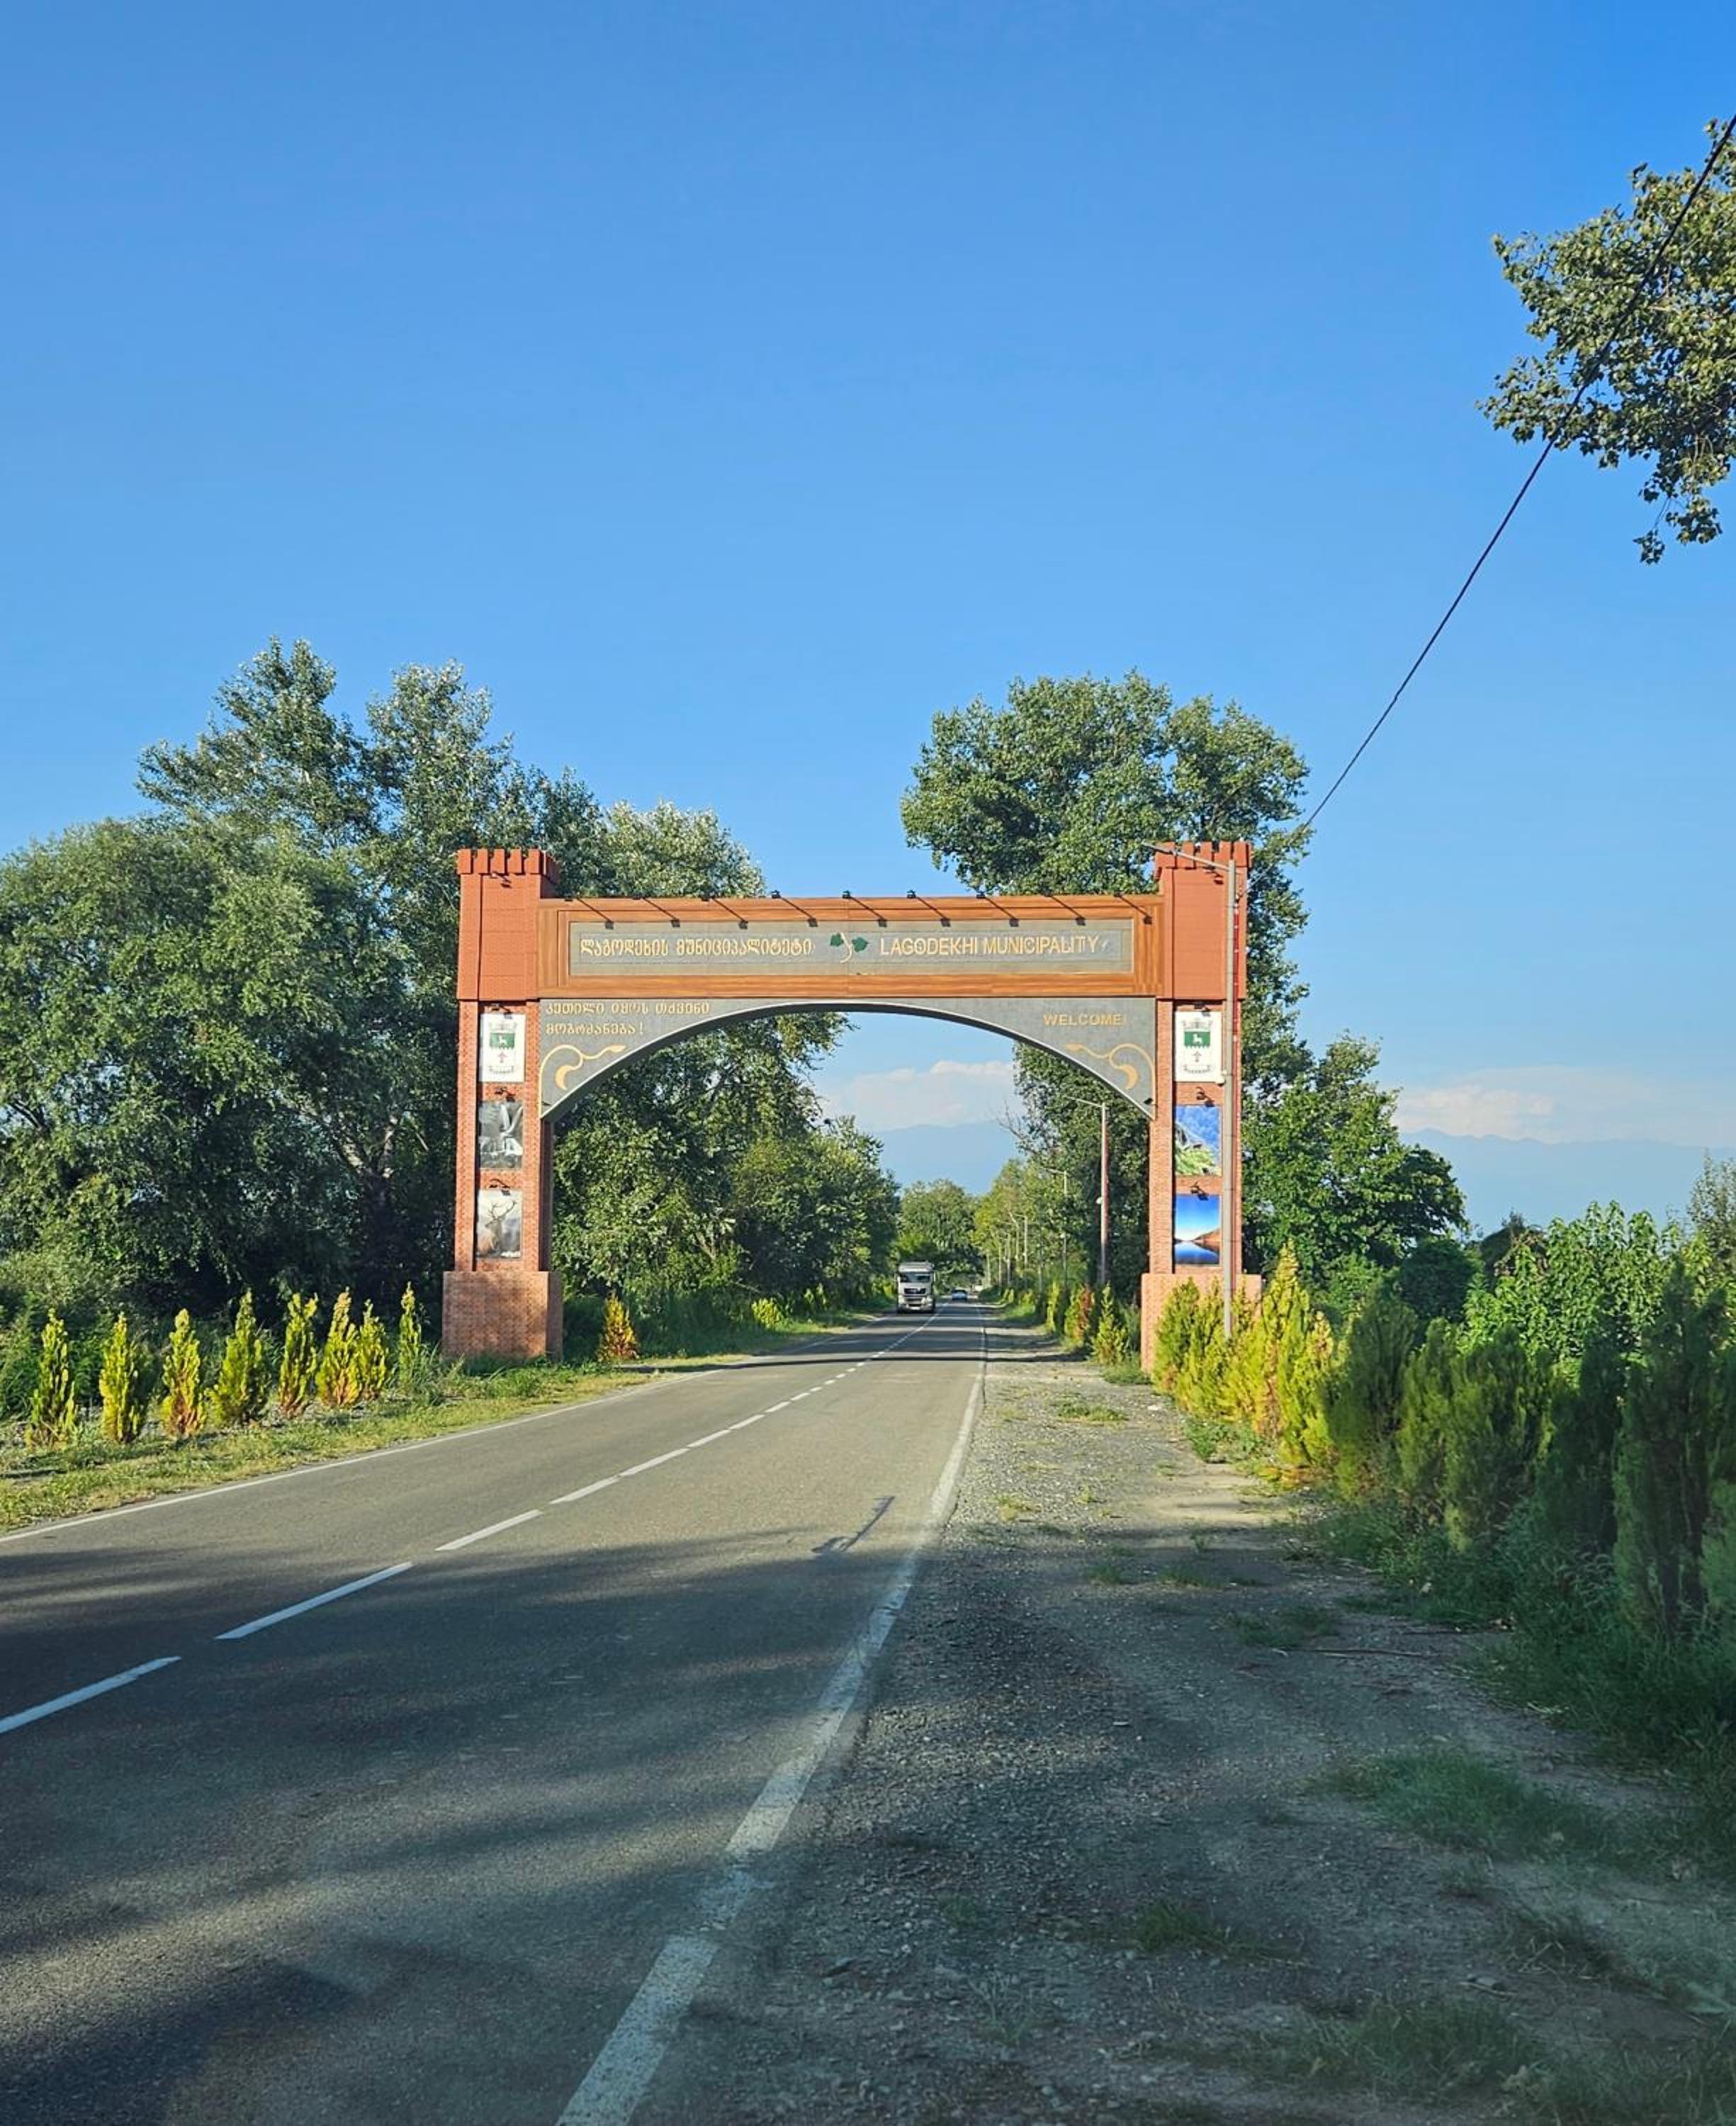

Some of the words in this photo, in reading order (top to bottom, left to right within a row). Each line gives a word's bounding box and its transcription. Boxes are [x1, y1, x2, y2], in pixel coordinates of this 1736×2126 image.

[580, 938, 669, 956] ლაგოდეხის
[675, 938, 812, 956] მუნიციპალიტეტი
[881, 936, 977, 955] LAGODEKHI
[983, 935, 1100, 954] MUNICIPALITY
[546, 1002, 604, 1015] კეთილი
[611, 1001, 648, 1015] იყოს
[655, 1001, 709, 1015] თქვენი
[1042, 1013, 1124, 1026] WELCOME
